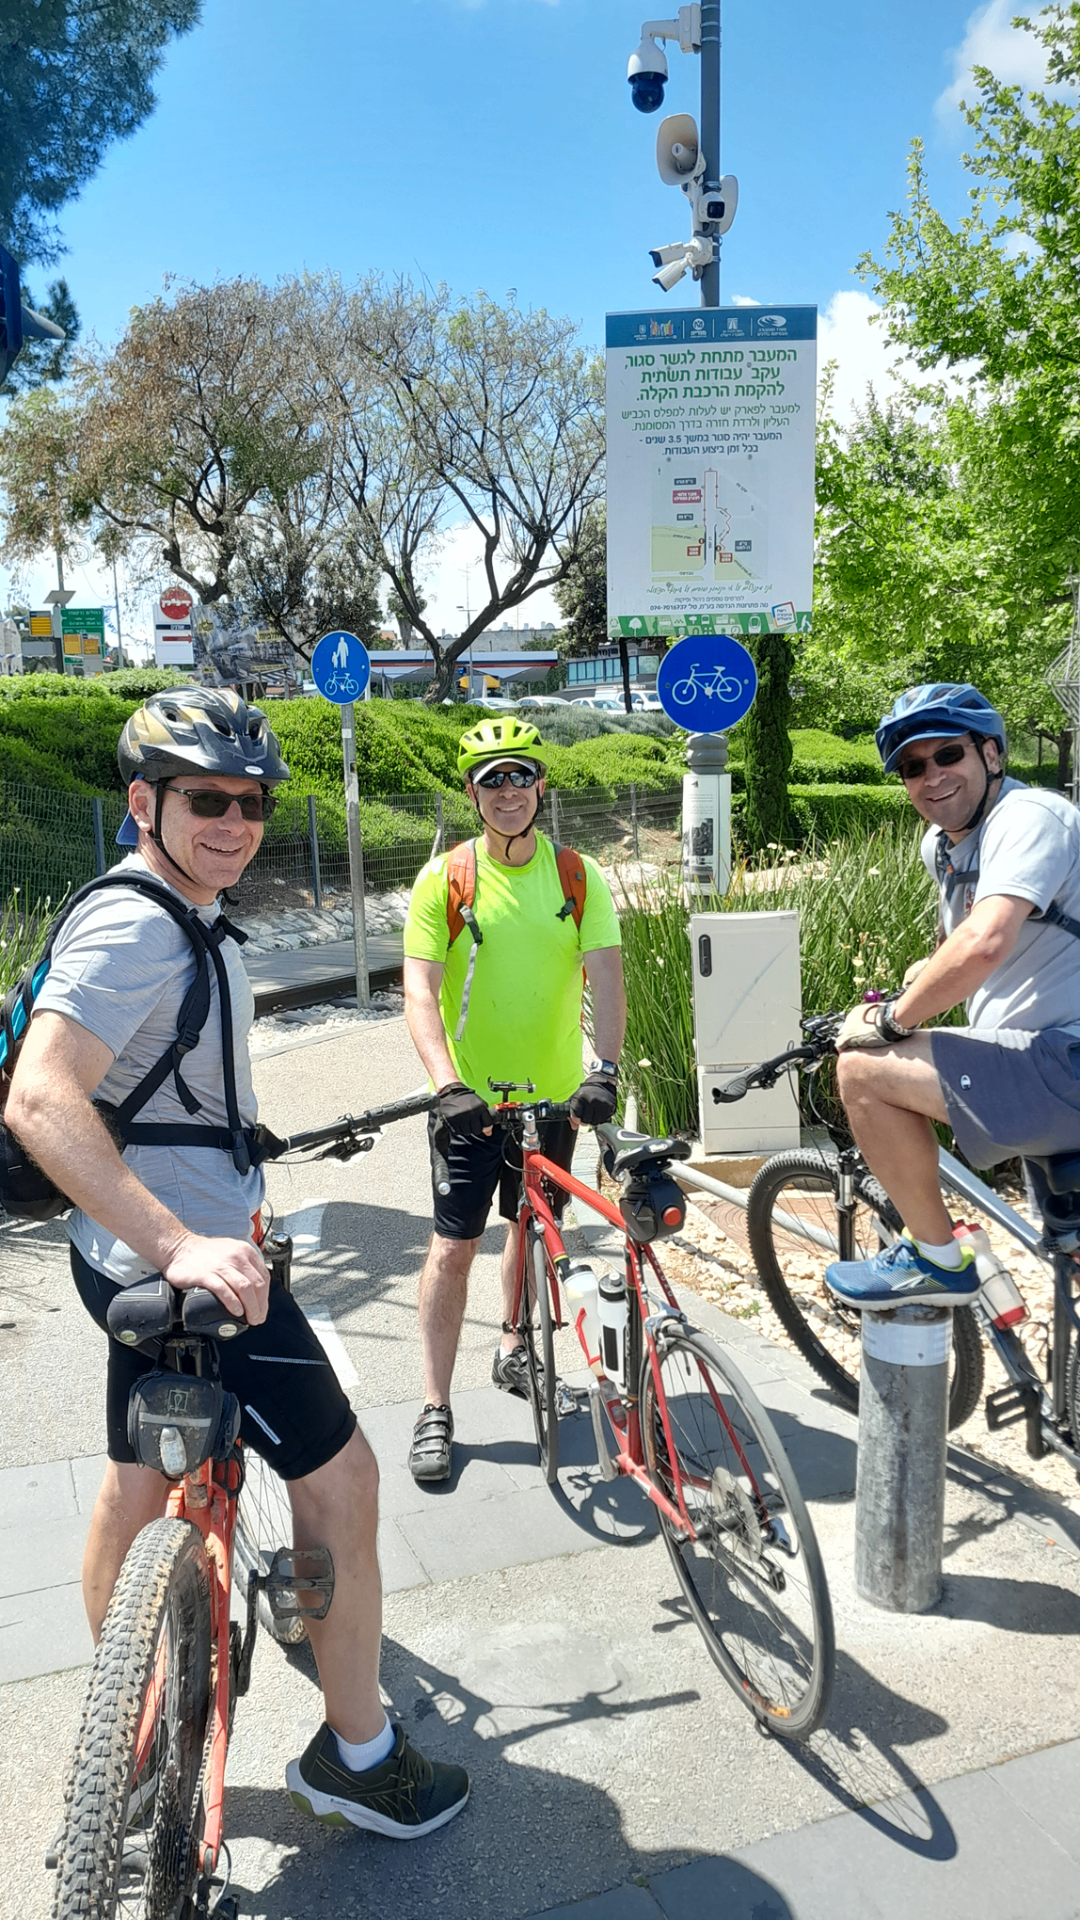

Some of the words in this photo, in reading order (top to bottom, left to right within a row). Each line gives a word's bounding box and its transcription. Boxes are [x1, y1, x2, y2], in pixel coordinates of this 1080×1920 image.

[660, 349, 695, 366] לגשר
[701, 350, 744, 363] מתחת
[750, 349, 797, 362] המעבר
[625, 354, 655, 369] סגור,
[641, 369, 690, 383] תשתית
[696, 368, 742, 381] עבודות
[751, 366, 780, 382] עקב
[636, 386, 677, 403] הקלה.
[683, 385, 729, 398] הרכבת
[734, 382, 784, 400] להקמת
[622, 409, 650, 419] הכביש
[654, 408, 684, 418] למפלס
[689, 405, 716, 416] לעלות
[720, 407, 730, 415] יש
[735, 404, 766, 417] לפארק
[770, 404, 800, 413] למעבר
[632, 422, 675, 431] המסומנת.
[679, 420, 702, 432] בדרך
[706, 420, 729, 428] חזרה
[733, 418, 759, 427] ולרדת
[764, 417, 789, 428] העליון
[645, 436, 665, 444] שנים
[669, 435, 681, 443] 3.5
[686, 434, 709, 445] במשך
[662, 446, 699, 456] העבודות.
[702, 446, 724, 454] ביצוע
[728, 445, 739, 455] זמן
[743, 444, 758, 453] בכל
